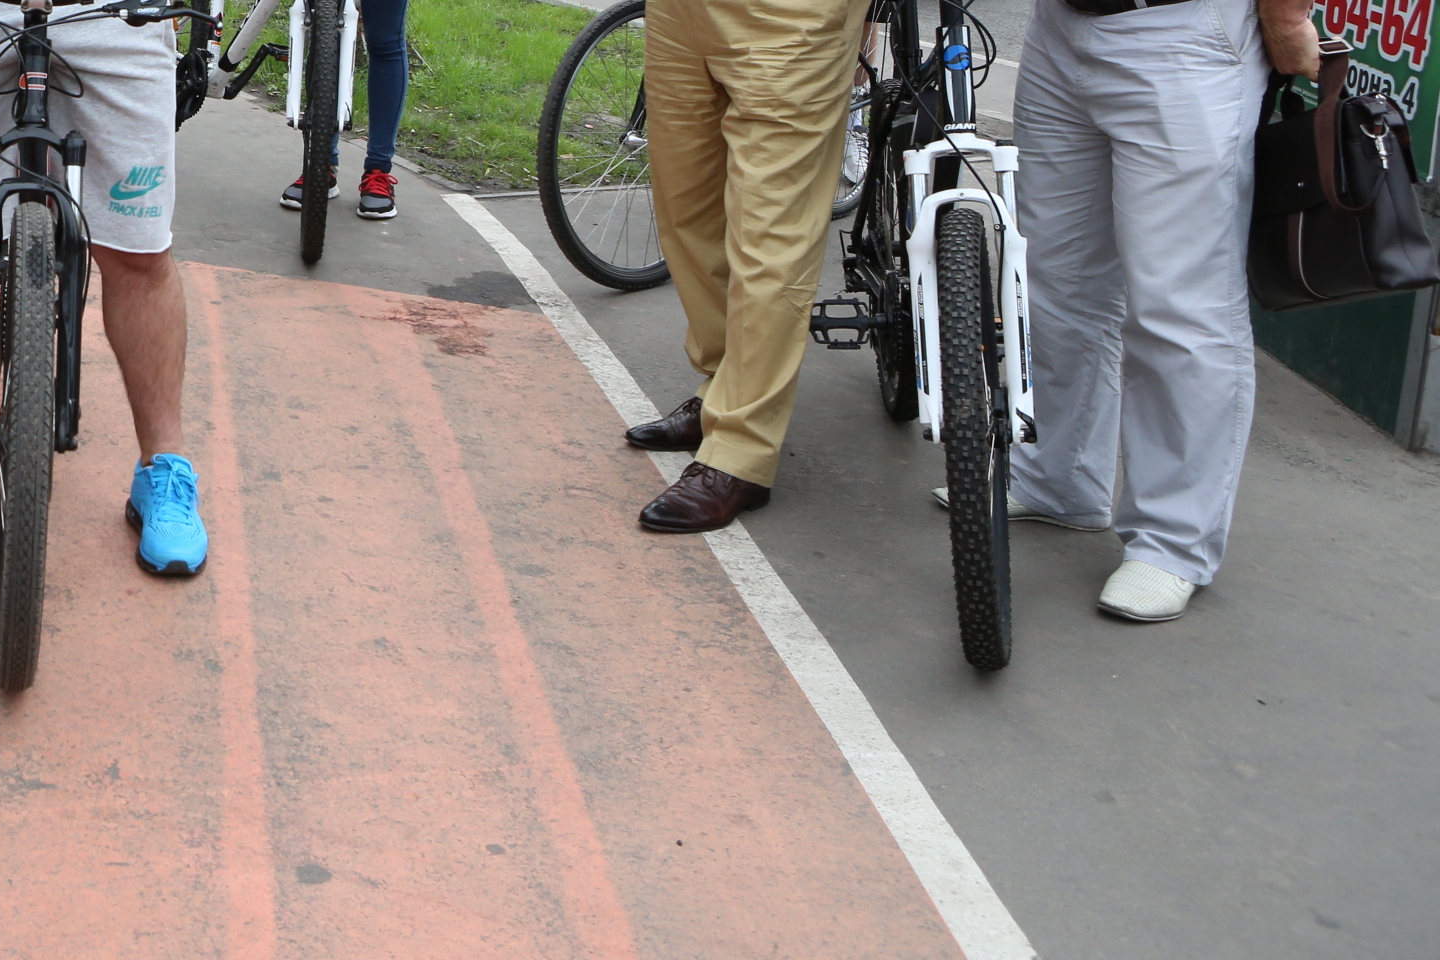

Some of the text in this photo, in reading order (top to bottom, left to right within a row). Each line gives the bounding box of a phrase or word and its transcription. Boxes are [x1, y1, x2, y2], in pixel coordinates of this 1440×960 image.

[944, 123, 976, 131] GIANT
[124, 166, 166, 186] NIKE
[108, 201, 137, 216] TRACK
